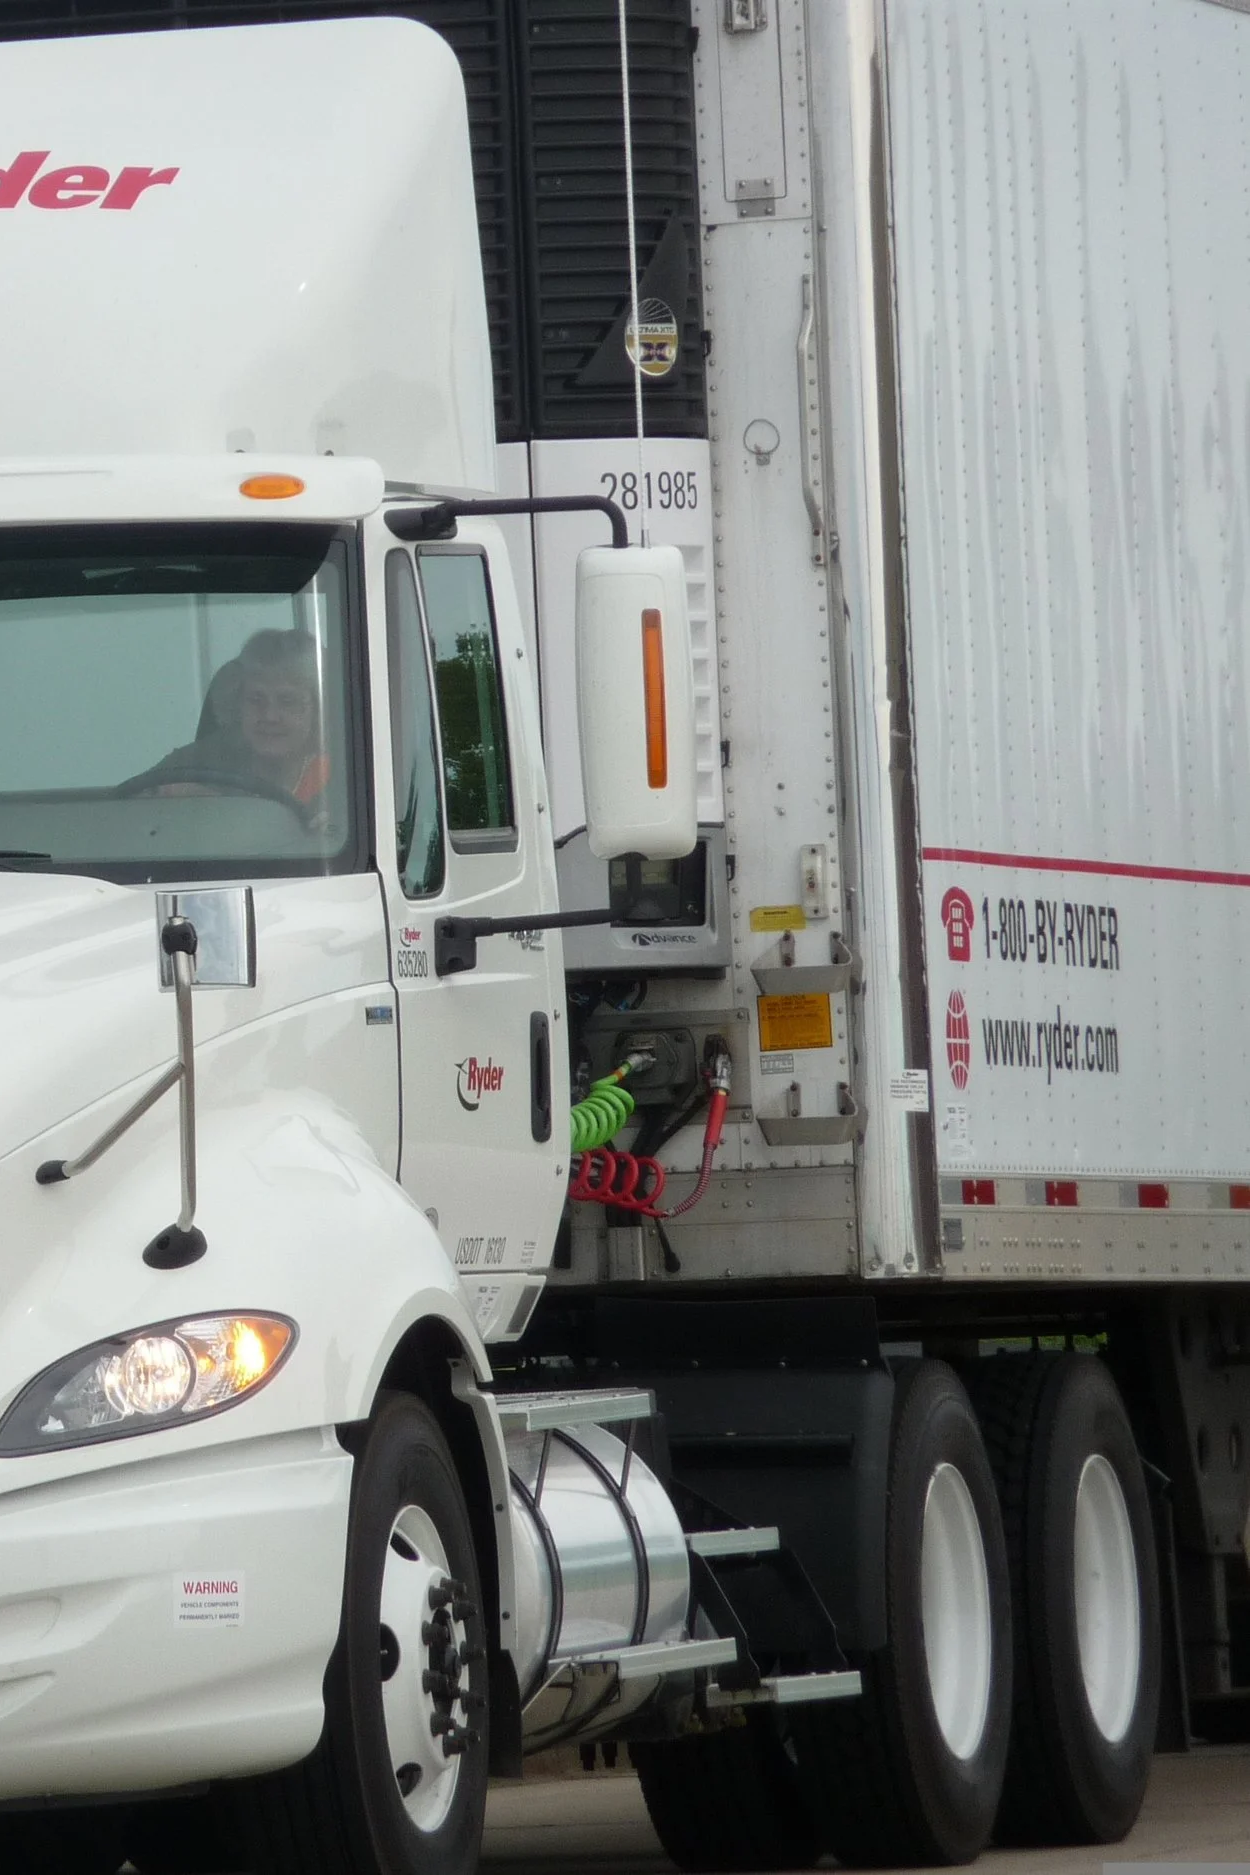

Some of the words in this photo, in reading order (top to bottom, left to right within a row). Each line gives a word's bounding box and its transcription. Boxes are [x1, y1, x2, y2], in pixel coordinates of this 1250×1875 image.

[600, 471, 698, 510] 281985
[404, 928, 421, 942] Ryder
[982, 896, 1120, 970] 1-800-BY-RYDER
[397, 950, 428, 977] 635280
[982, 1004, 1120, 1086] www.ryder.com
[467, 1056, 504, 1099] Ryder
[455, 1237, 484, 1264] USDOT
[183, 1581, 239, 1594] WARNING
